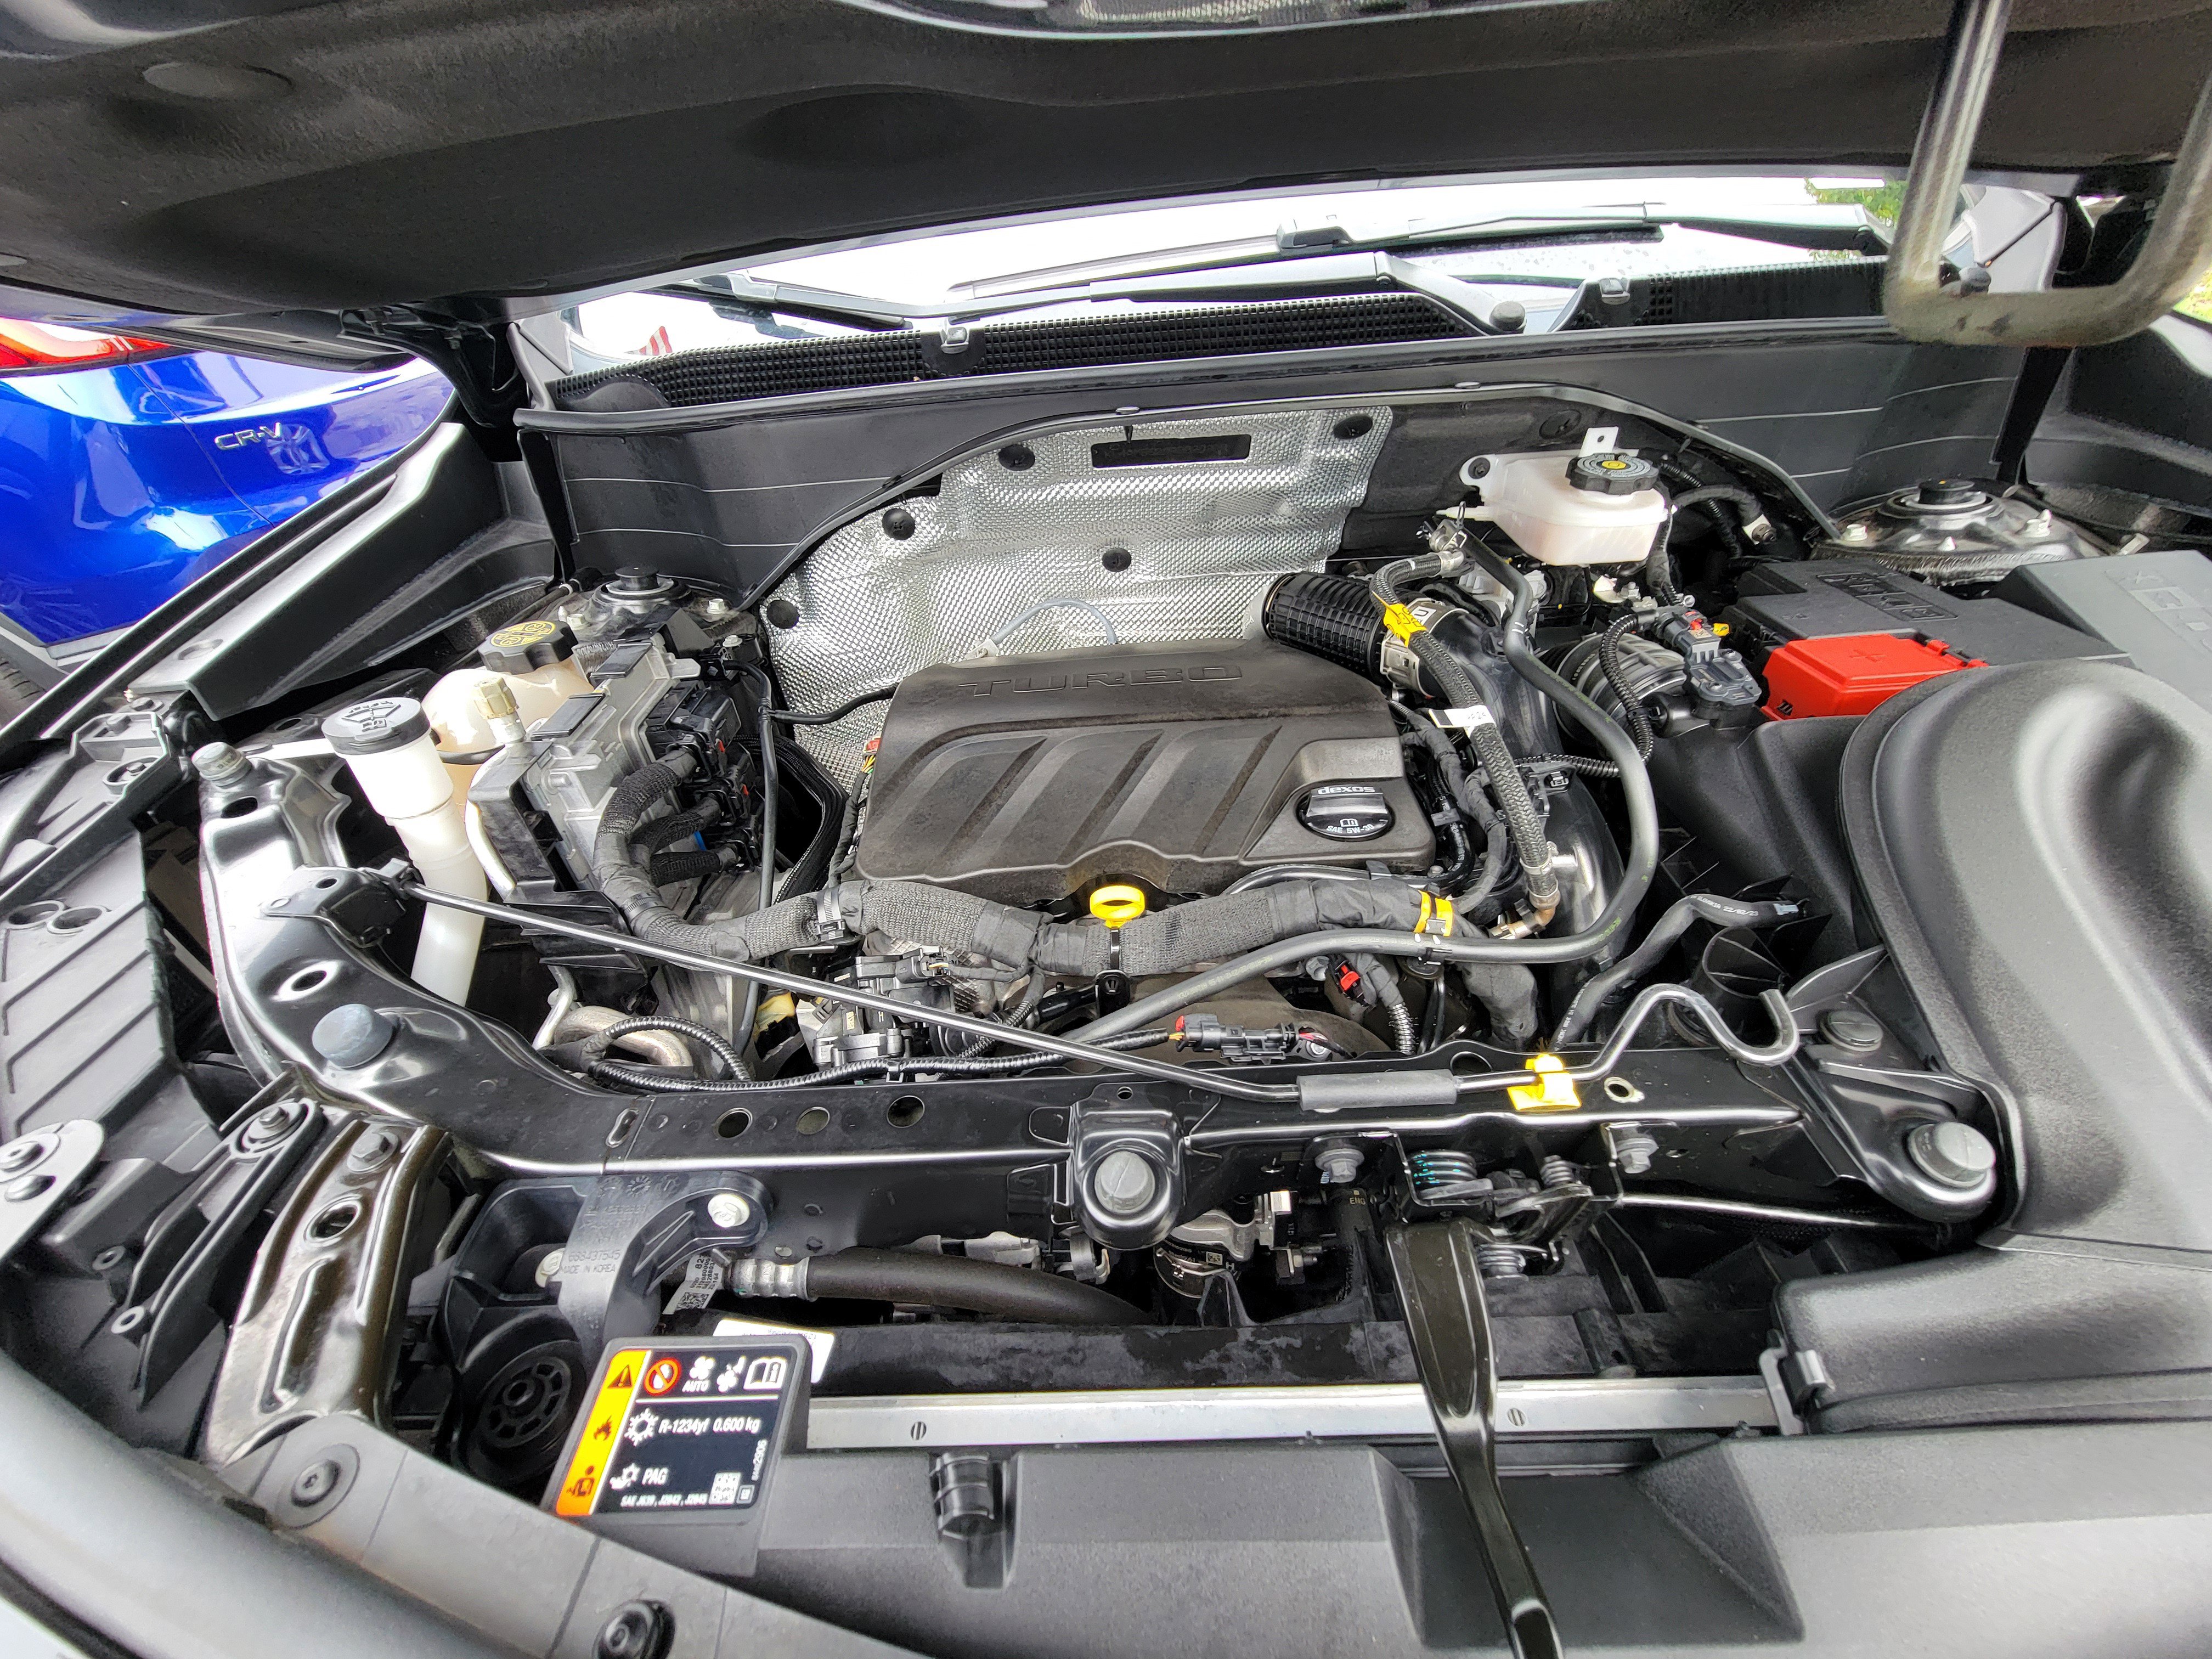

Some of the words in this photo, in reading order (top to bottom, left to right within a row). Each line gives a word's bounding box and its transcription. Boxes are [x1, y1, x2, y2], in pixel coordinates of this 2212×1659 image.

[214, 422, 282, 450] CR-V
[958, 664, 1243, 697] TURBO
[1318, 786, 1375, 795] dexos
[1326, 825, 1343, 833] SAE
[1346, 823, 1375, 833] 5W-30
[1350, 1197, 1366, 1205] ENG
[592, 1263, 616, 1273] KOREA
[682, 1380, 709, 1392] AUTO
[658, 1418, 710, 1436] R-1234yf
[713, 1417, 744, 1432] 0.600
[744, 1417, 761, 1435] kg
[642, 1468, 669, 1485] PAG
